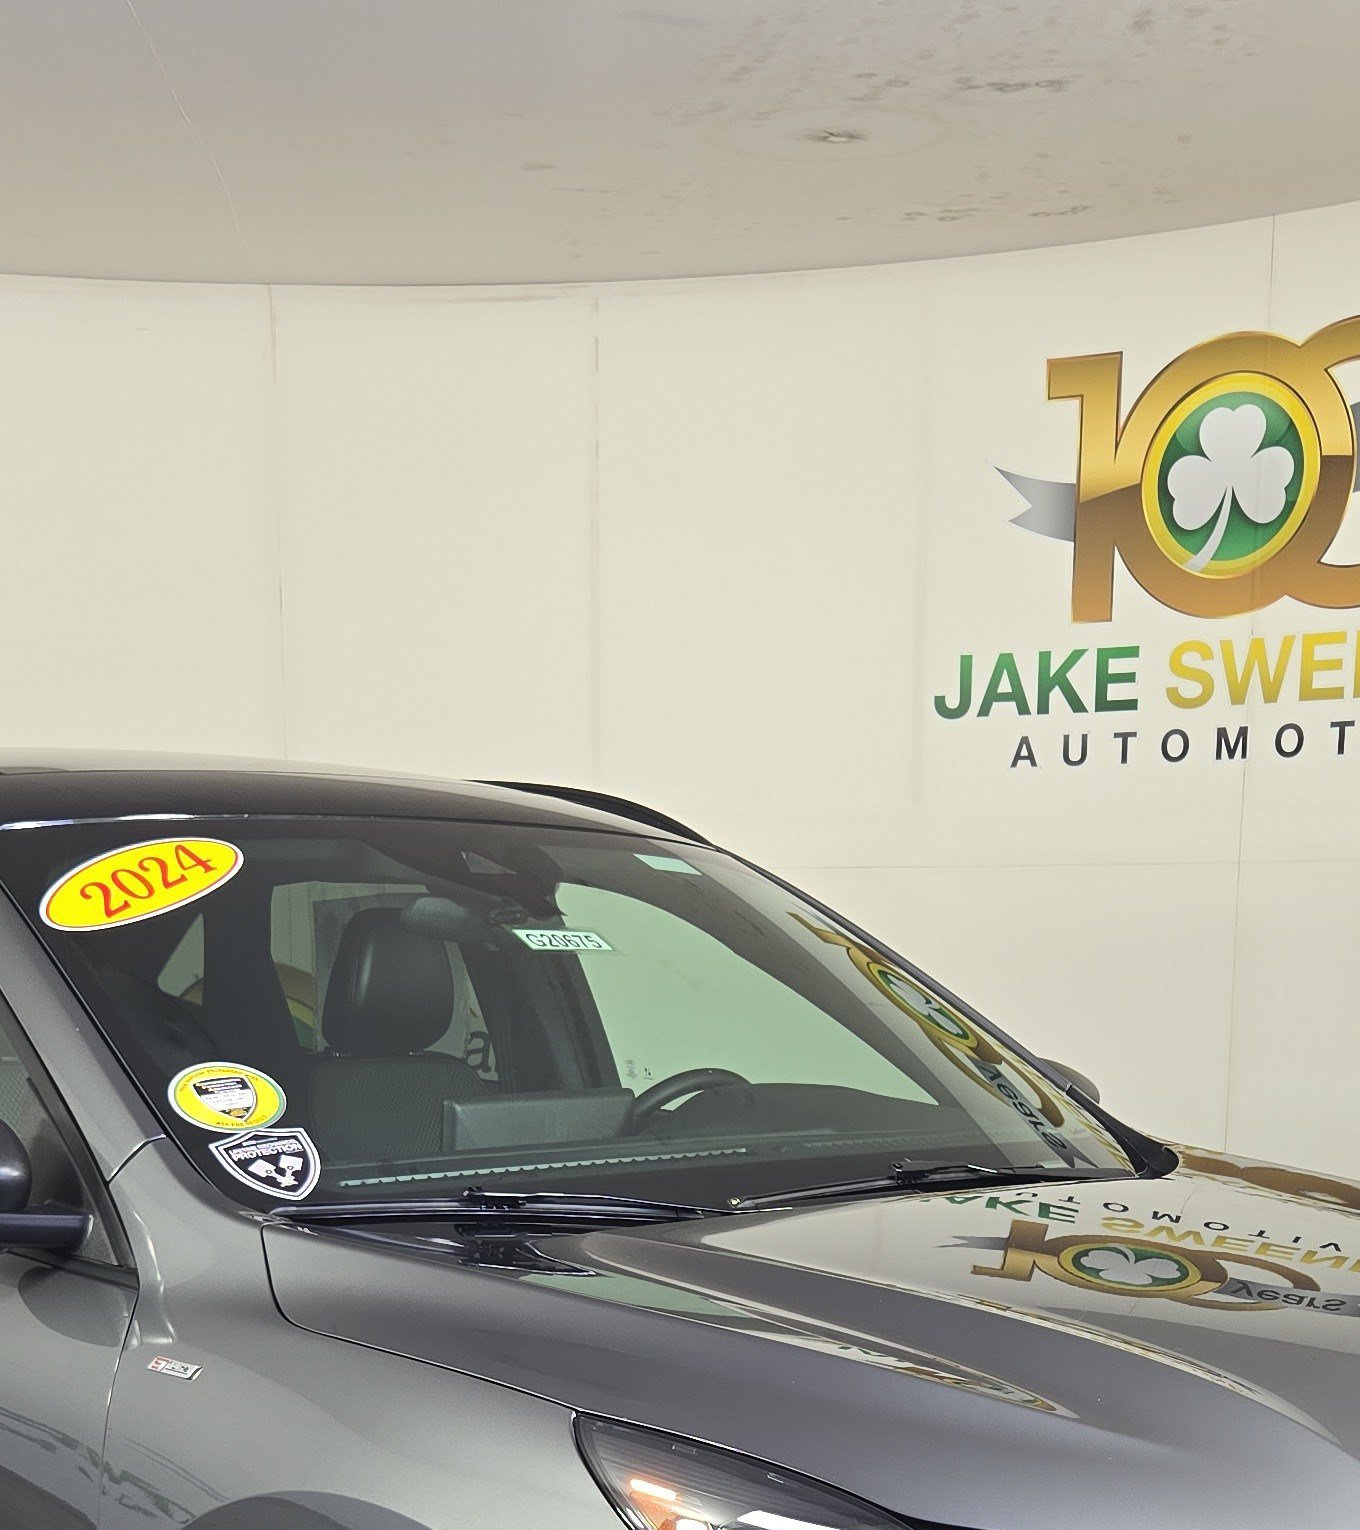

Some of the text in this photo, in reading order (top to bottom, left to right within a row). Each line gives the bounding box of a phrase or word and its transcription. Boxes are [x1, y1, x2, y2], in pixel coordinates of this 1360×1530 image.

[934, 645, 1140, 721] JAKE
[80, 844, 217, 918] 2024
[526, 933, 602, 948] G20675
